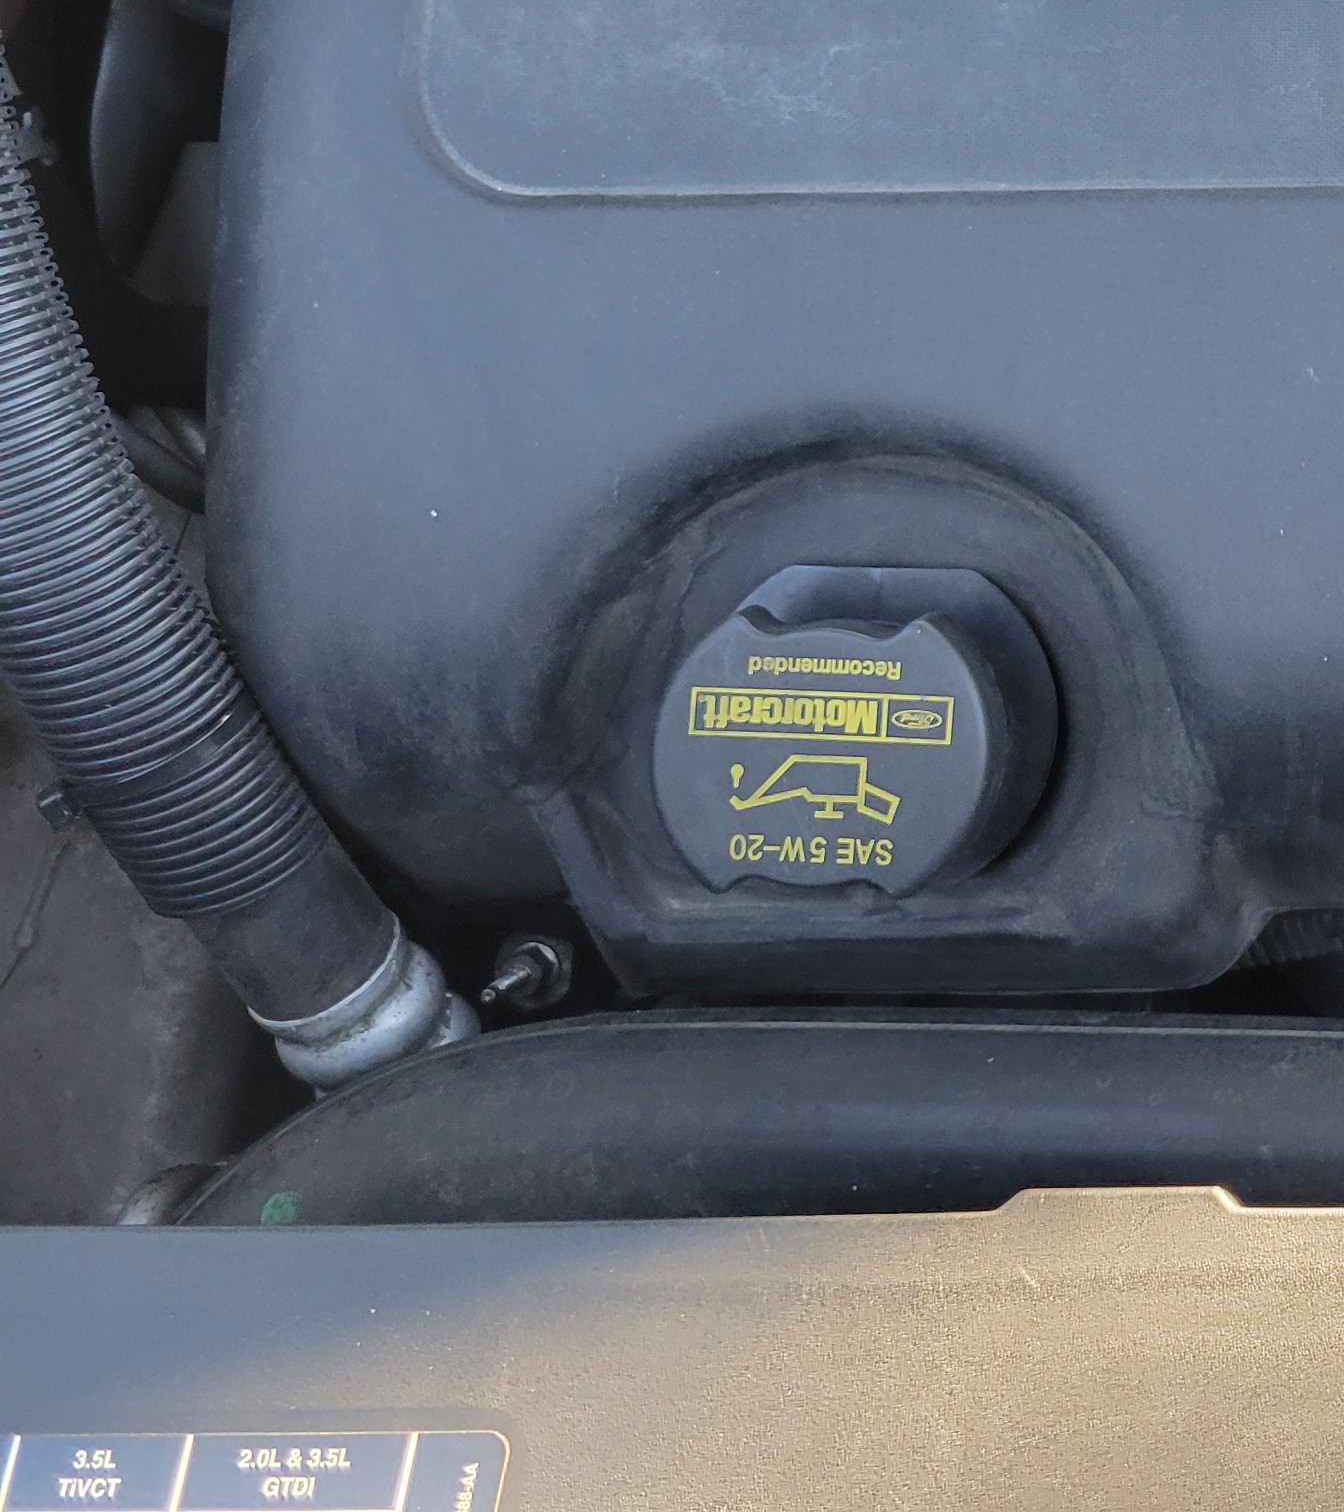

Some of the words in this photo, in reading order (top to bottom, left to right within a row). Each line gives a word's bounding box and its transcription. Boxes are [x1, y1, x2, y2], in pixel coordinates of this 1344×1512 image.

[748, 655, 902, 680] Recommended
[700, 693, 881, 734] Motorcraft
[837, 836, 894, 866] SAE
[72, 1450, 117, 1470] 3.5L
[238, 1448, 282, 1469] 2.0L
[286, 1448, 304, 1468] &
[307, 1447, 352, 1468] 3.5L
[58, 1477, 122, 1500] TiVCT
